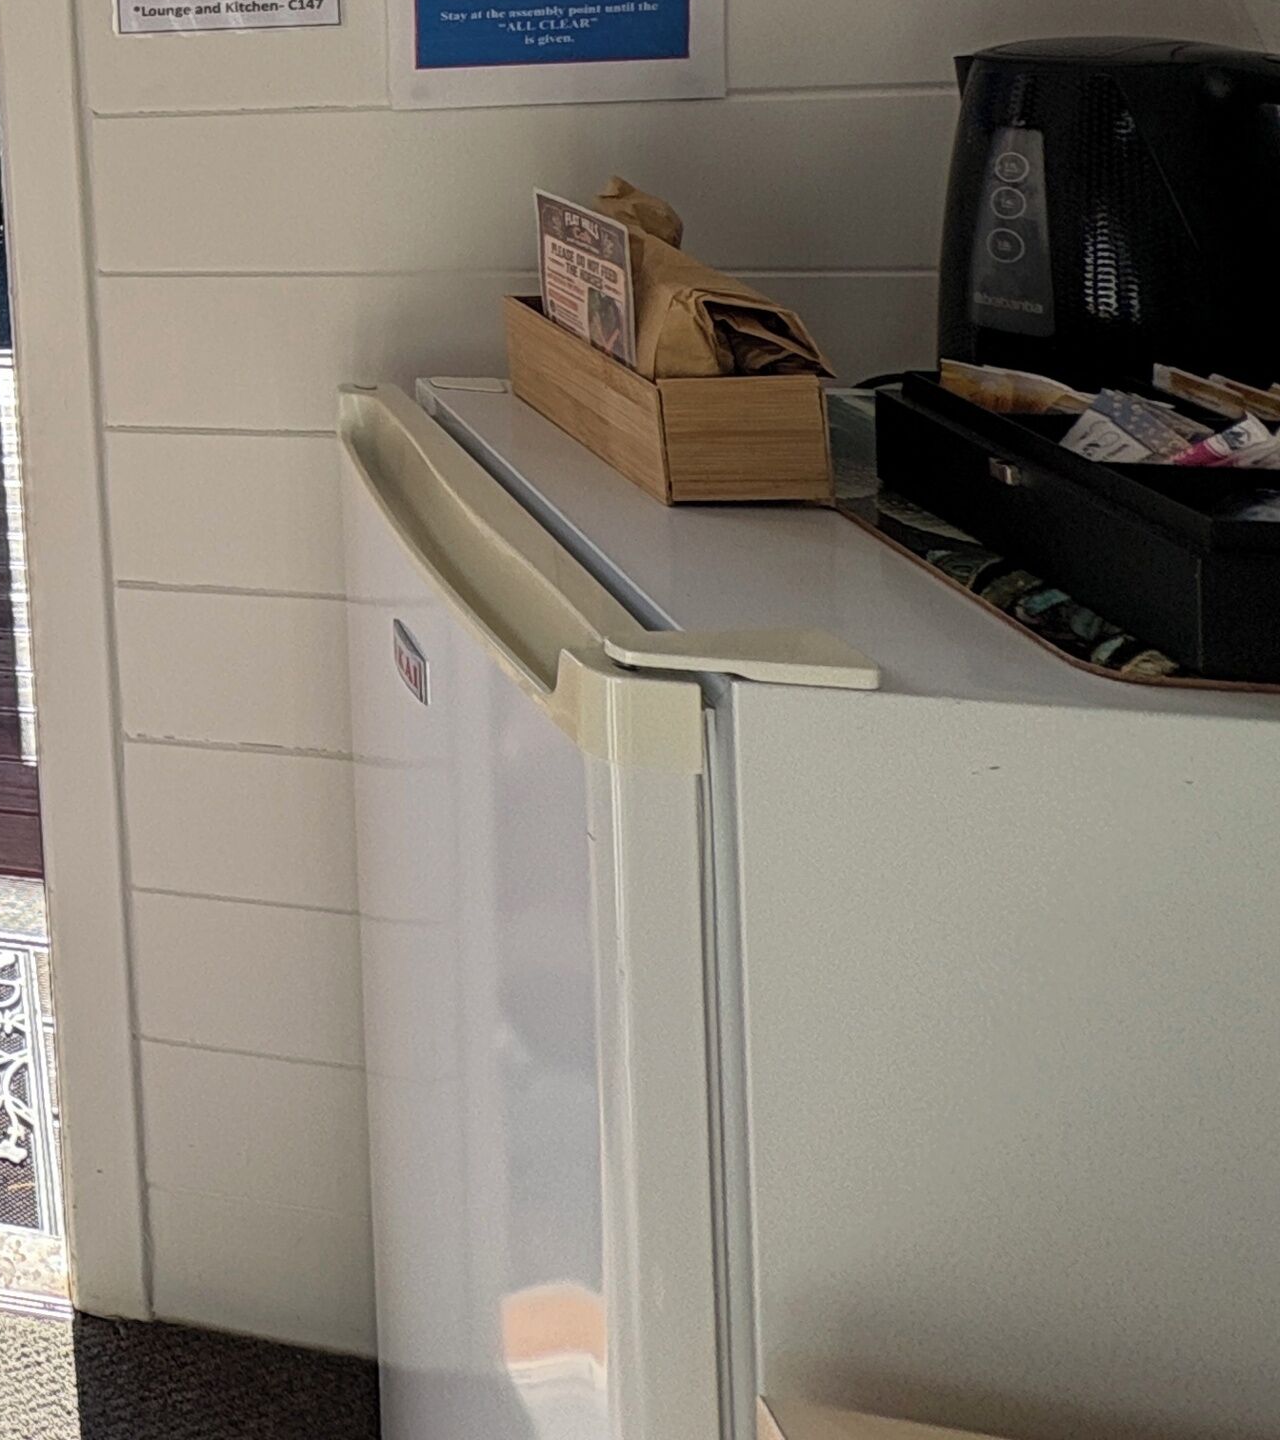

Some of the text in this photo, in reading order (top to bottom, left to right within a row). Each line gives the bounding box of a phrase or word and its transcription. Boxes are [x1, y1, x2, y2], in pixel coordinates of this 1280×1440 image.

[194, 2, 222, 15] and
[440, 0, 659, 23] Stay at the assembly point until the
[524, 34, 535, 46] is
